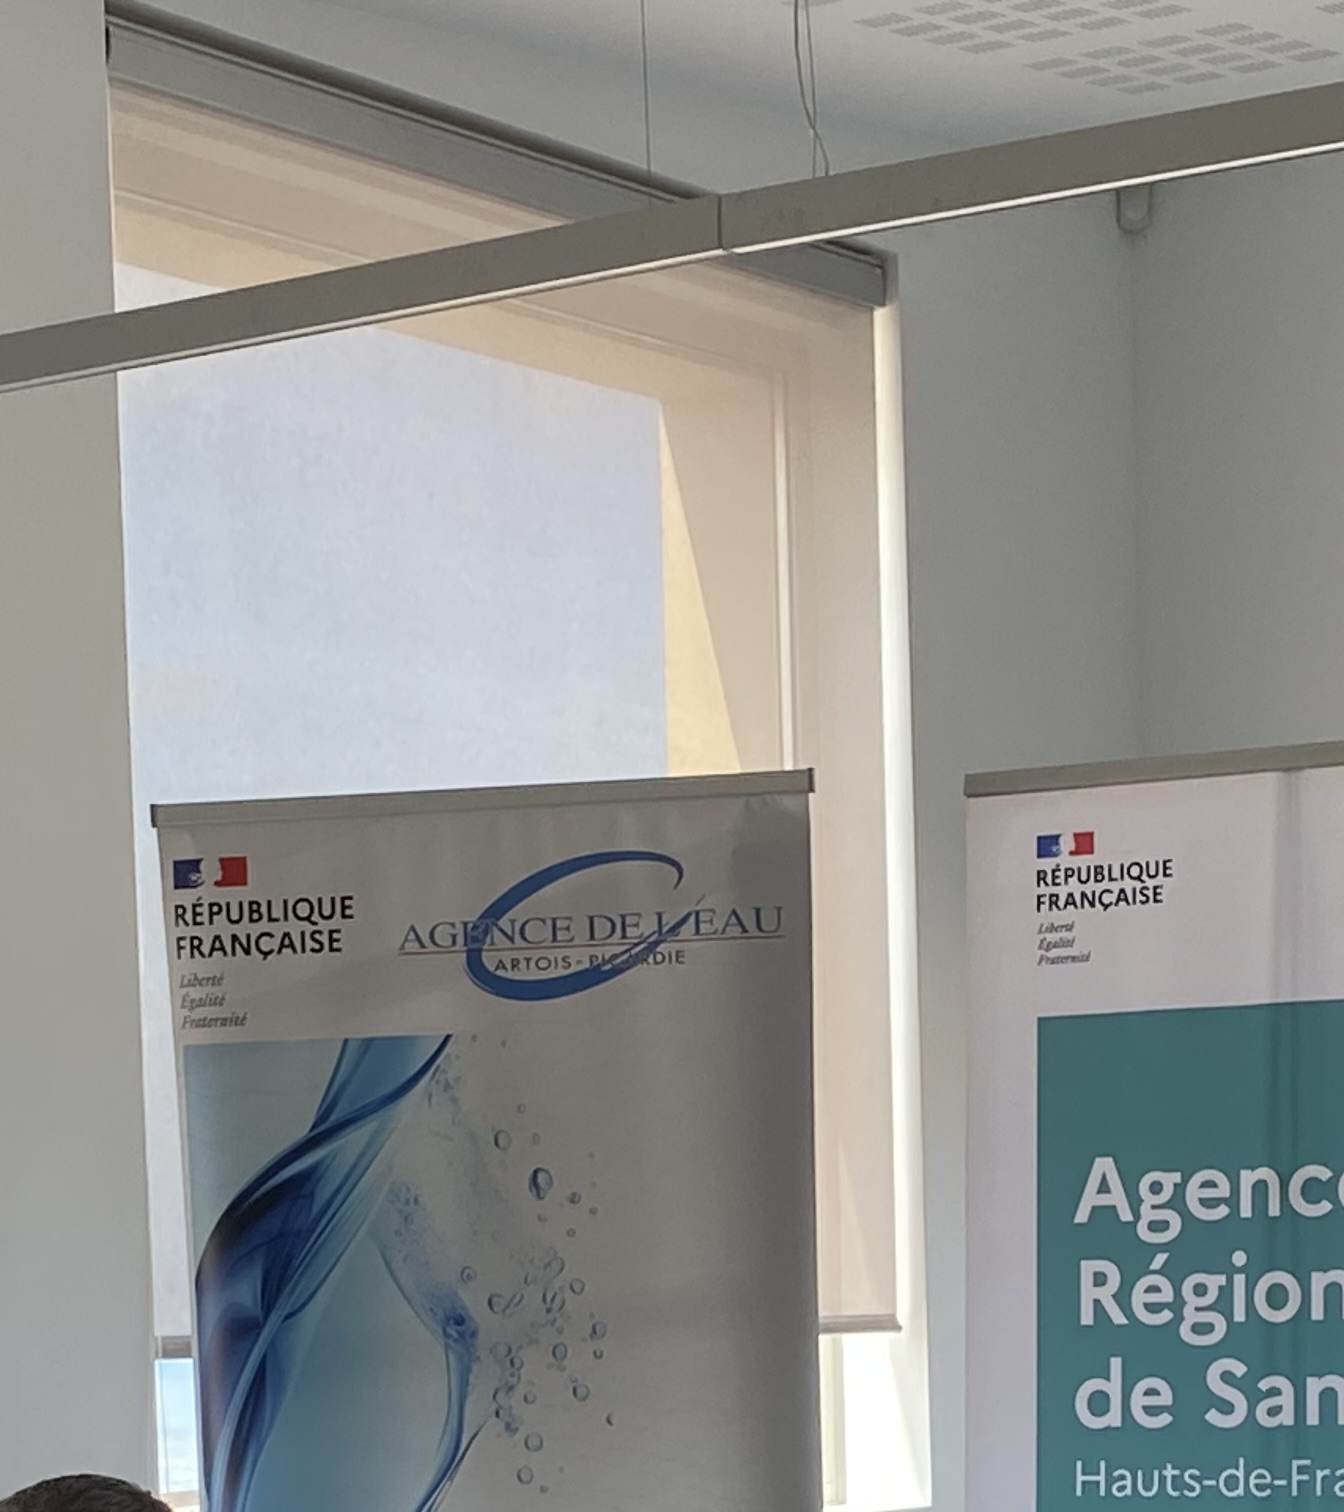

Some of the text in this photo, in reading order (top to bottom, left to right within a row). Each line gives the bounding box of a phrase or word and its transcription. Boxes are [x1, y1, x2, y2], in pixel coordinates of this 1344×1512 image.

[1036, 858, 1174, 888] RÉPUBLIQUE
[174, 895, 355, 928] RÉPUBLIQUE
[1036, 884, 1164, 913] FRANÇAISE
[400, 914, 575, 951] AGENCE
[586, 911, 645, 941] DE
[1037, 920, 1075, 935] Liberté
[176, 928, 343, 961] FRANÇAISE
[179, 973, 225, 989] Liberté
[1074, 1356, 1174, 1429] de
